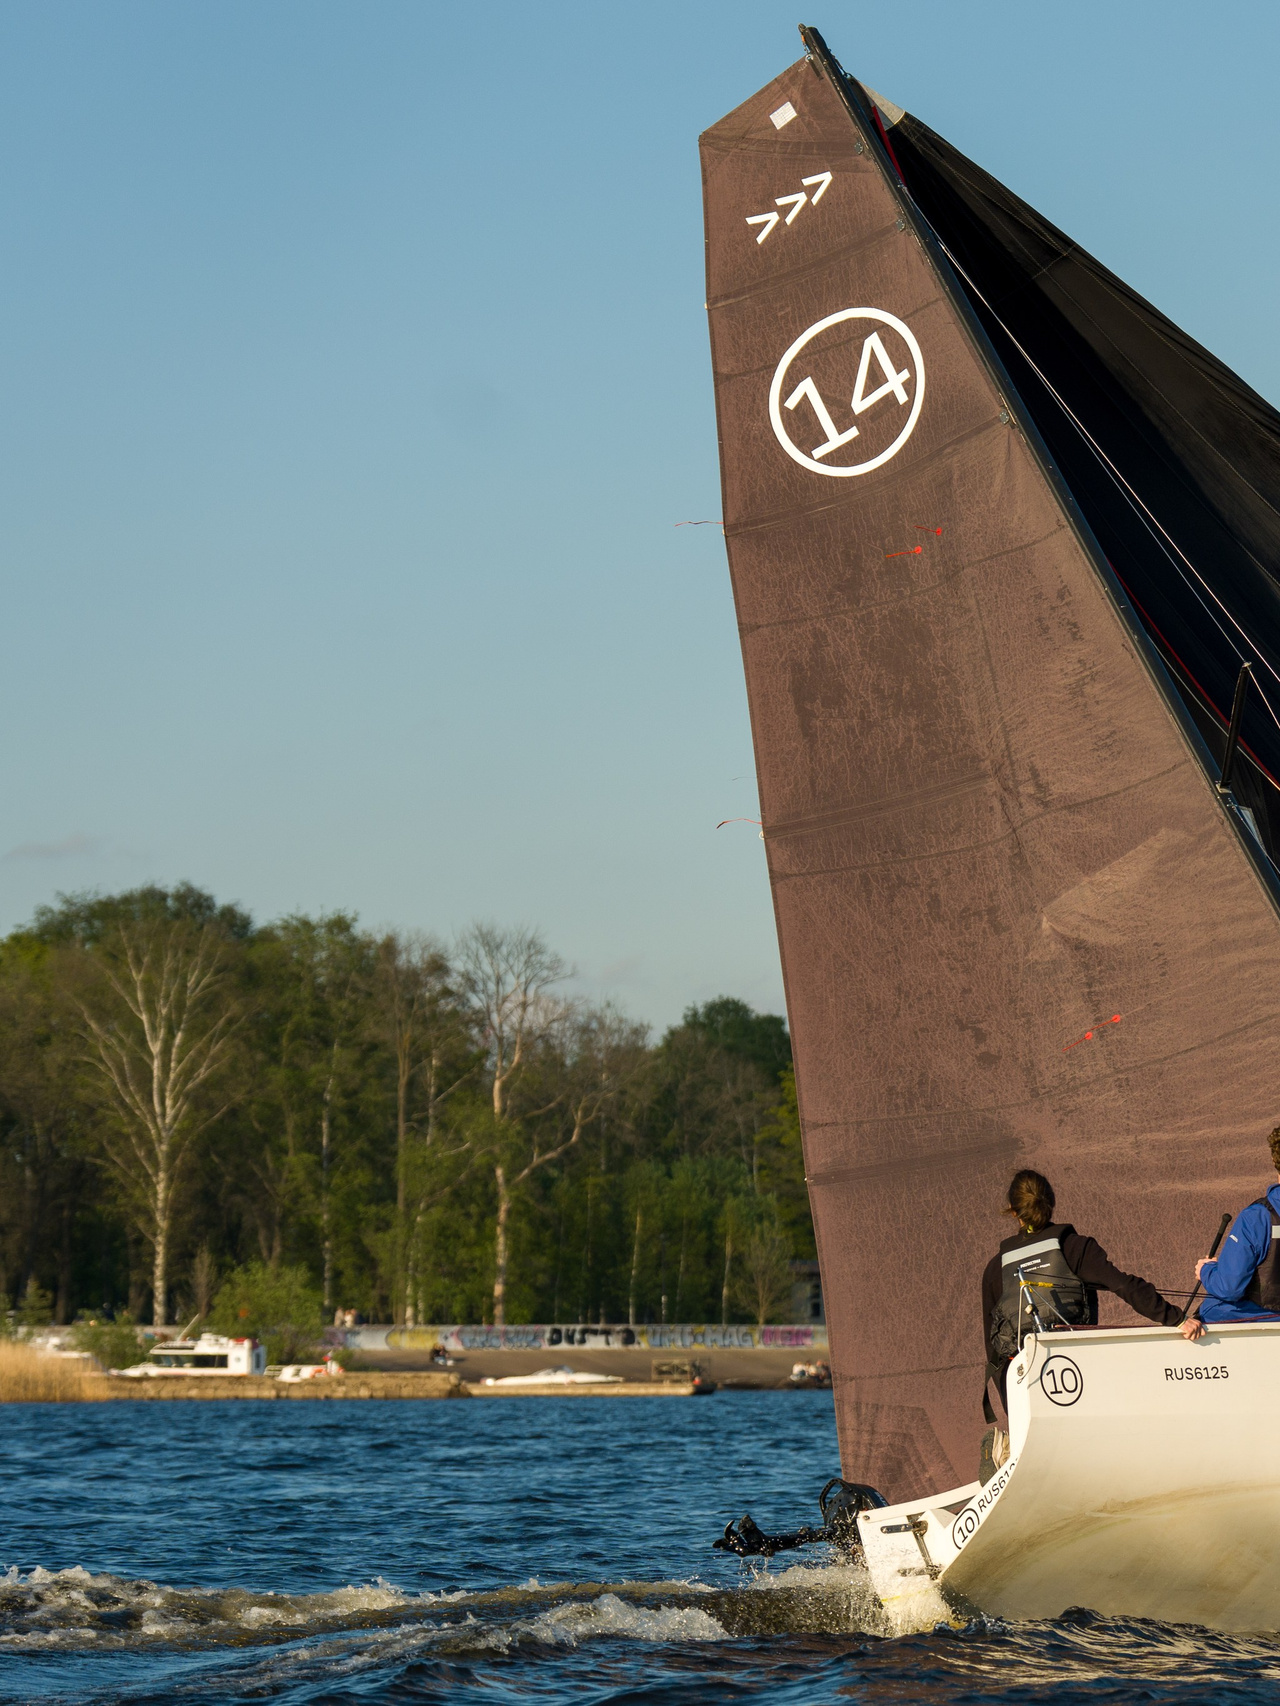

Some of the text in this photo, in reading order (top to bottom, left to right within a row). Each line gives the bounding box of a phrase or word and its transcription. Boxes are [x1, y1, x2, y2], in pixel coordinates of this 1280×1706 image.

[783, 331, 912, 461] 14
[1045, 1367, 1079, 1396] 10
[1164, 1366, 1230, 1381] RUS6125
[957, 1516, 975, 1543] 10
